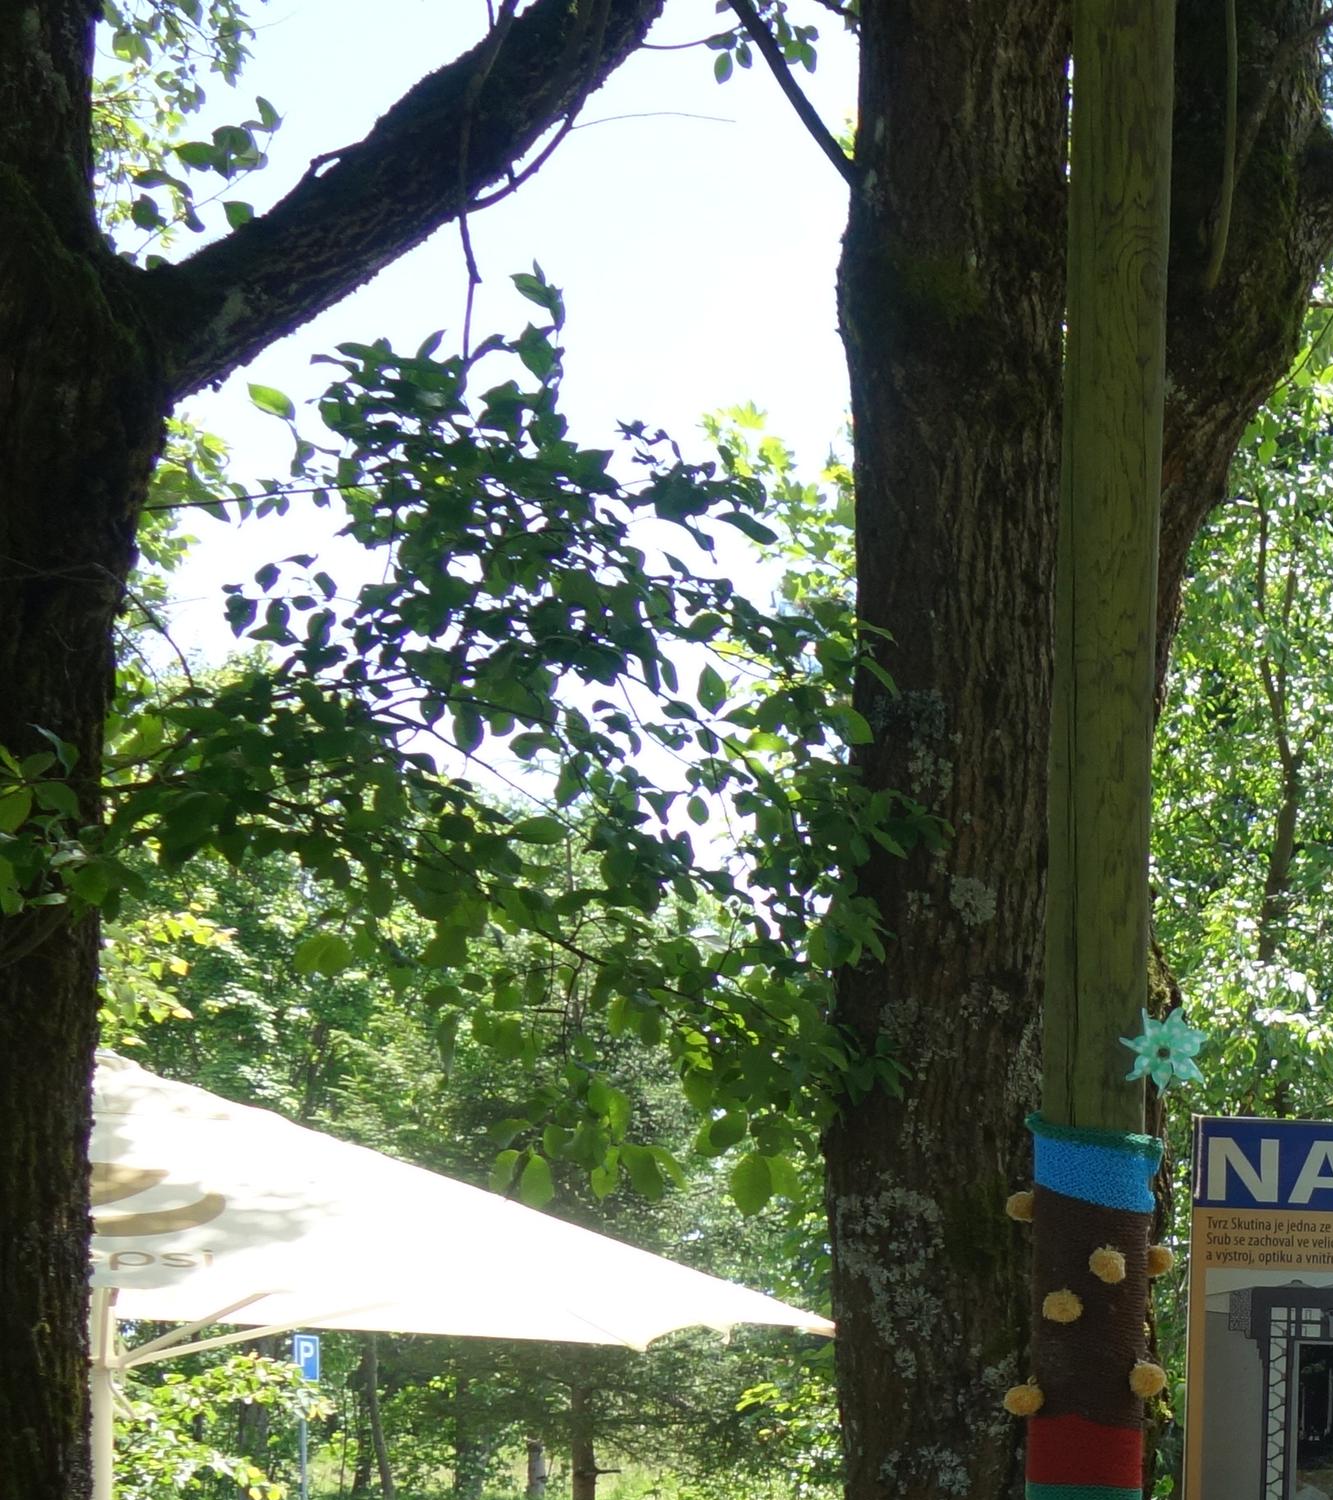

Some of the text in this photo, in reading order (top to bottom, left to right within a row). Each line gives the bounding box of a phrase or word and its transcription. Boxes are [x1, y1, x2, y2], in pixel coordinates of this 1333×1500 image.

[1274, 1218, 1284, 1235] je
[1319, 1223, 1332, 1234] ze
[300, 1341, 314, 1366] P
